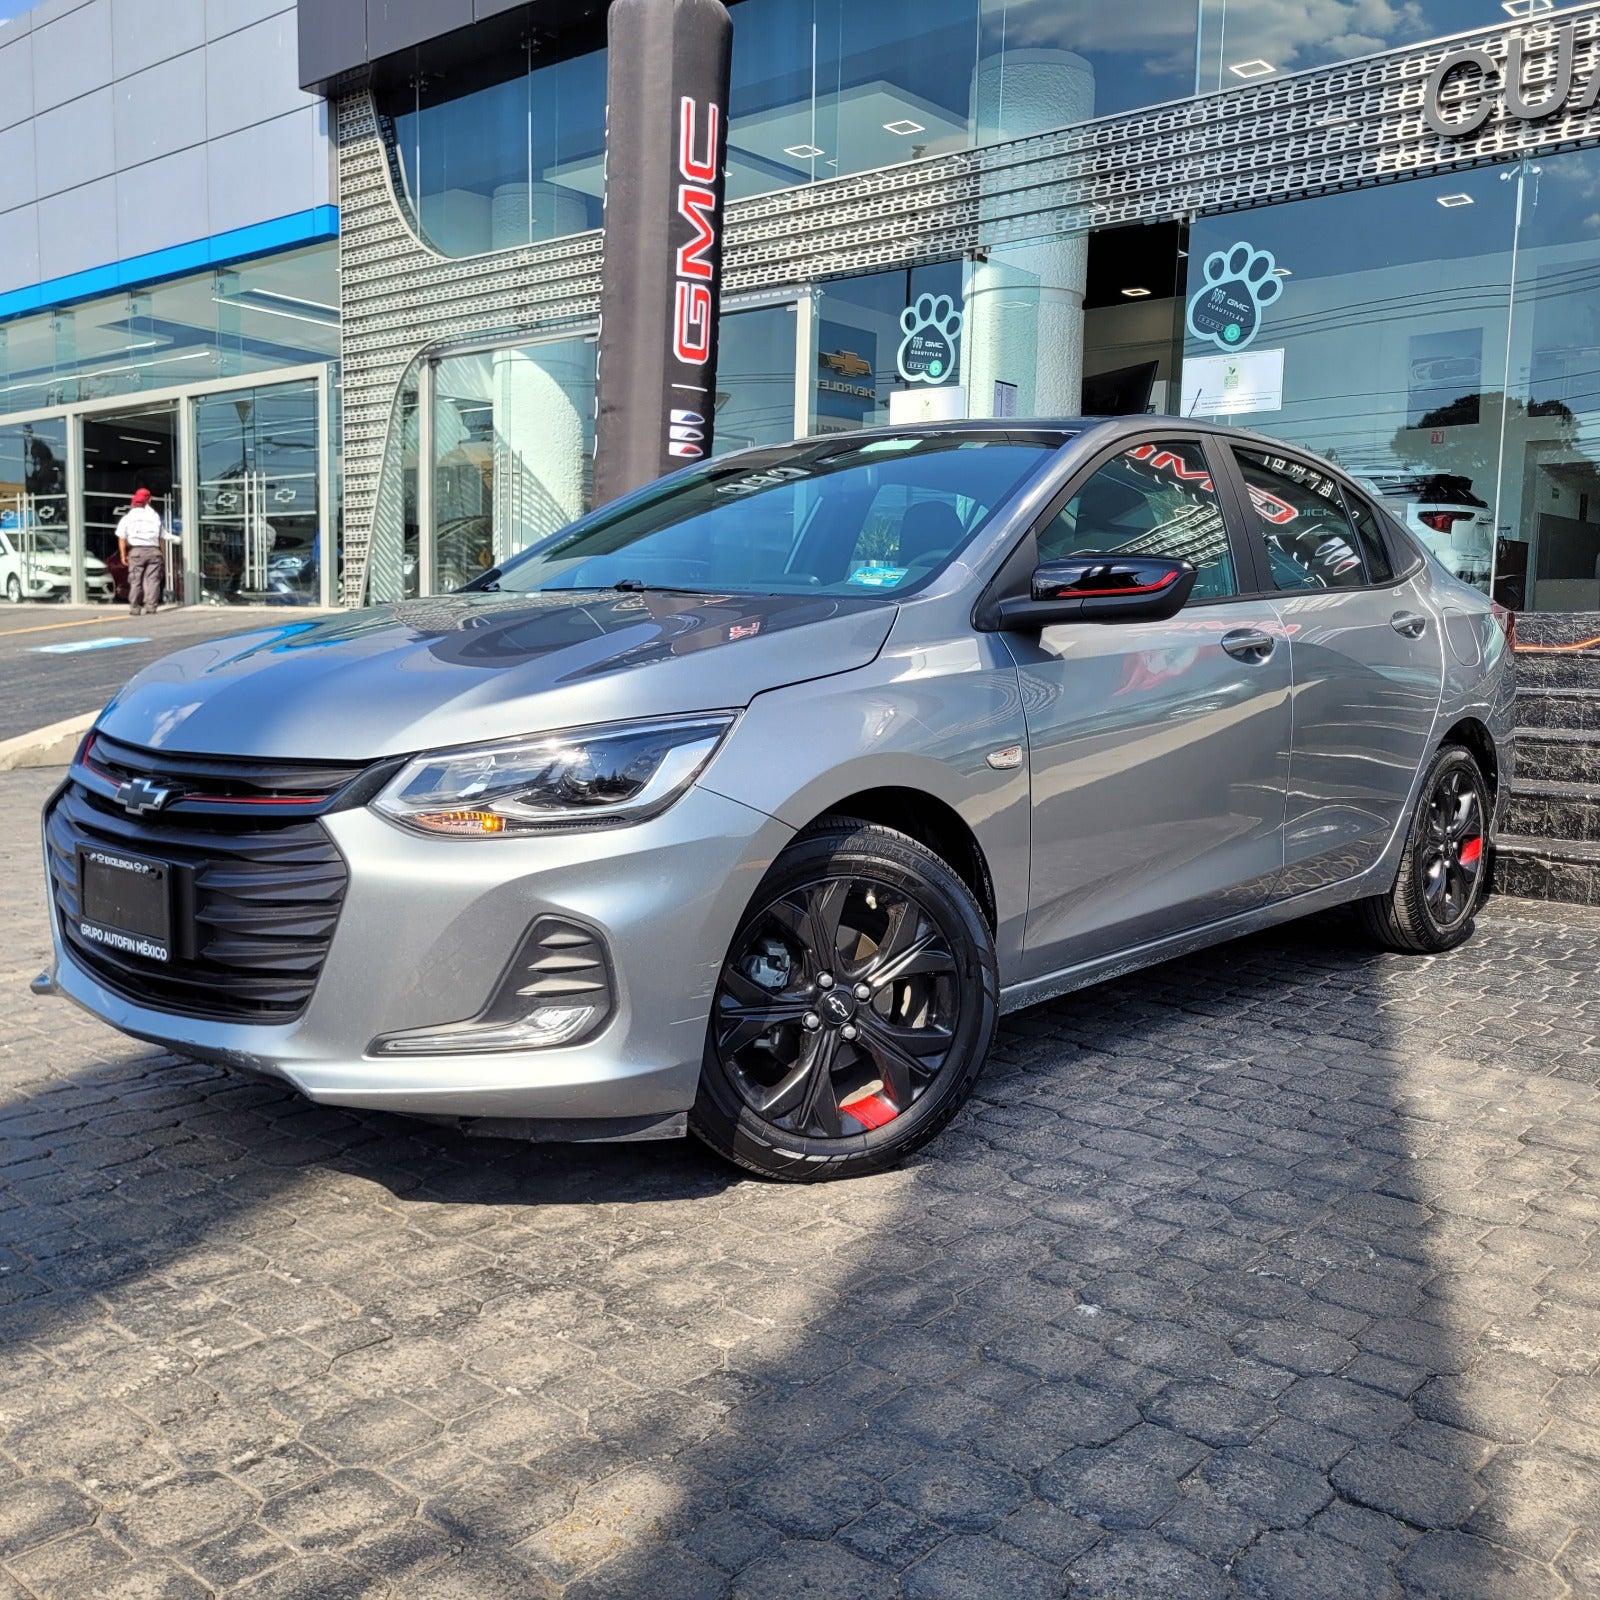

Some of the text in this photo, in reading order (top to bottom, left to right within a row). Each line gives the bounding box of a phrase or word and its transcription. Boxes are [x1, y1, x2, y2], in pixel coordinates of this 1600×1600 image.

[673, 96, 719, 366] GMC
[1227, 298, 1250, 313] GMC
[924, 341, 944, 349] GMC
[80, 923, 167, 961] GRUPO AUTOFIN MÉXICO
